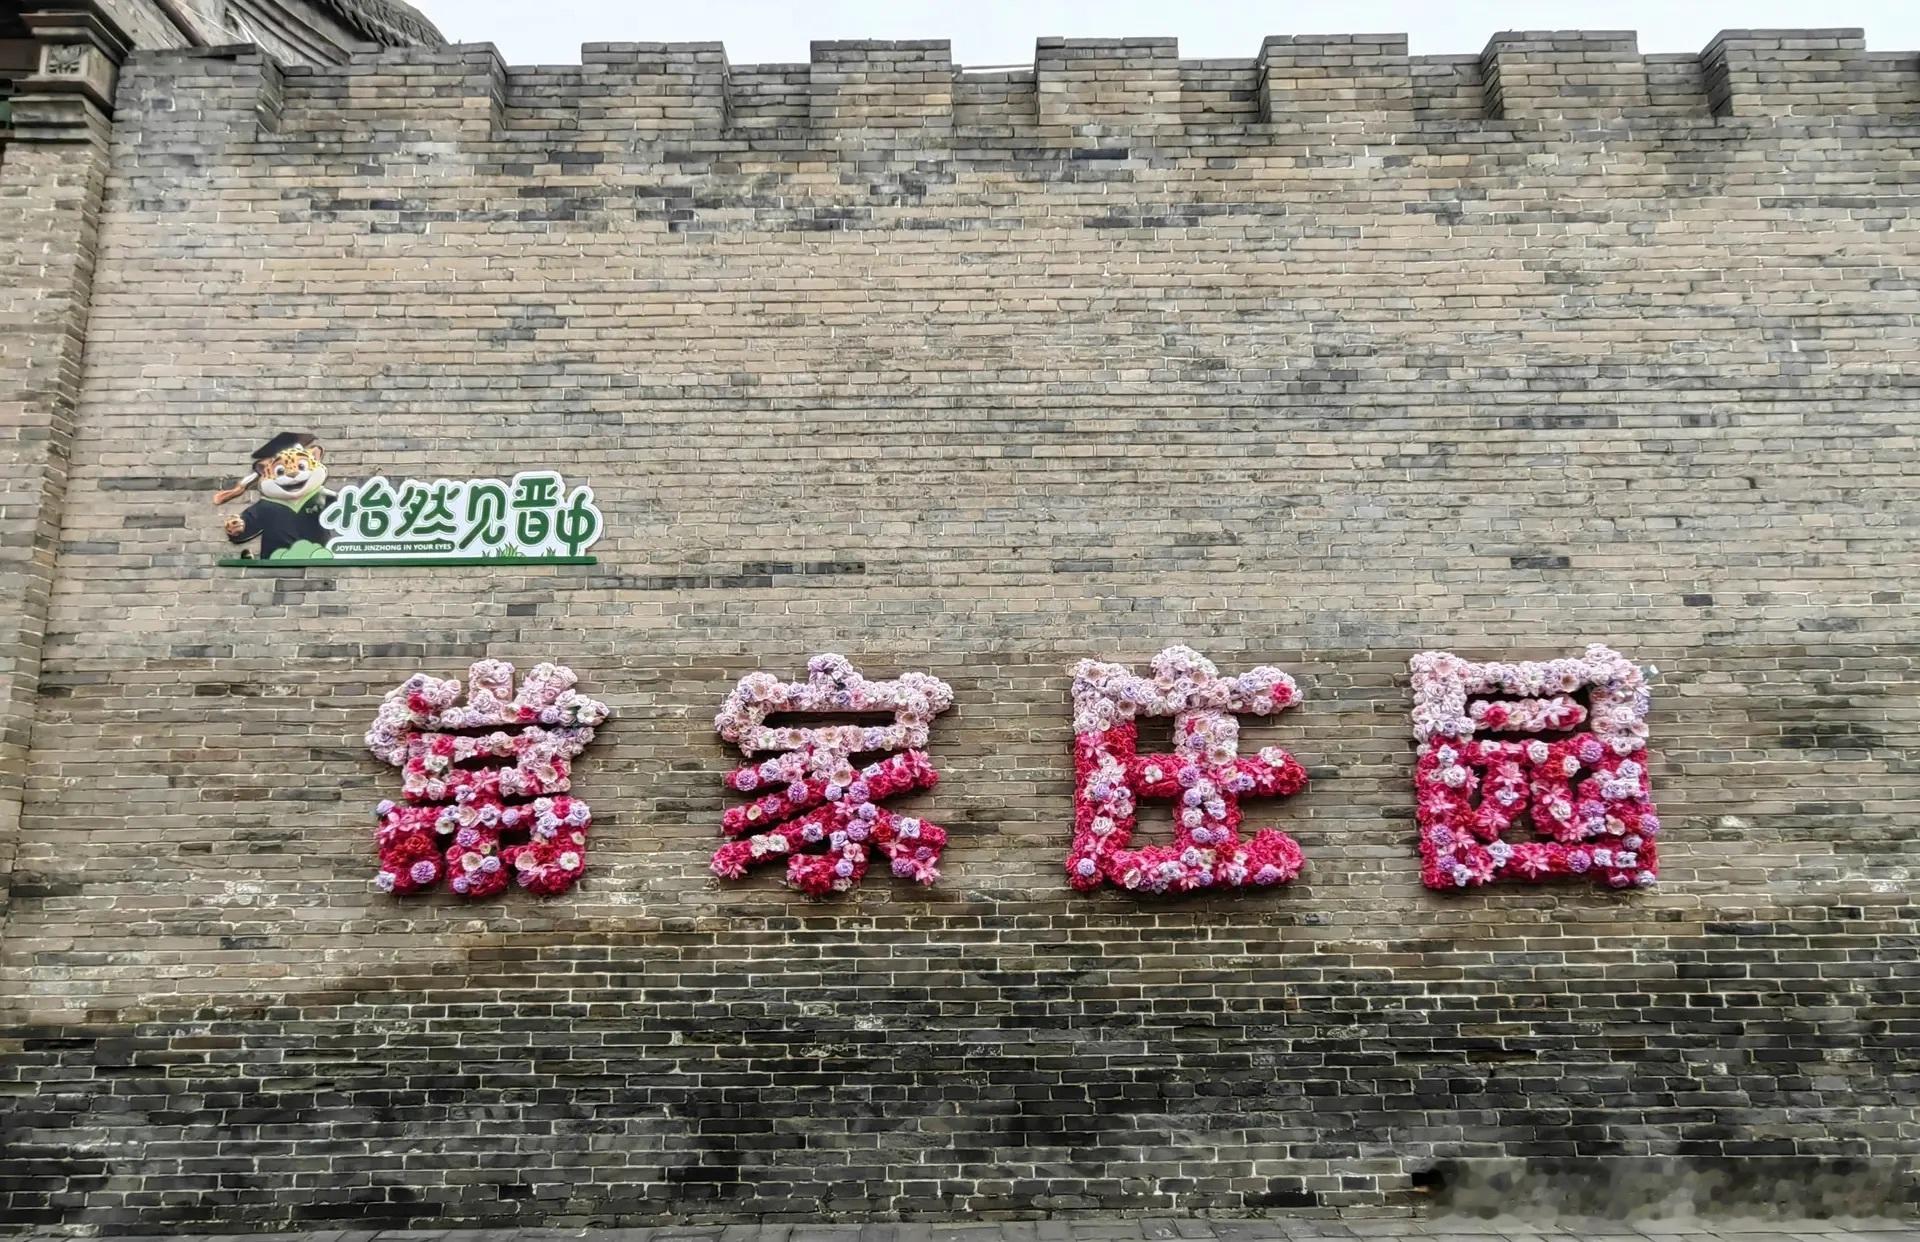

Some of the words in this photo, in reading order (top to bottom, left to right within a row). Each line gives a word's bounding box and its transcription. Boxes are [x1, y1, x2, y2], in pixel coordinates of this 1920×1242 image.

[327, 477, 596, 556] 怡然见晋中
[335, 544, 362, 552] JOYFUL
[364, 544, 402, 552] JINZHONG
[403, 543, 412, 551] IN
[413, 543, 433, 551] YOUR
[364, 643, 1660, 896] 常家庄园
